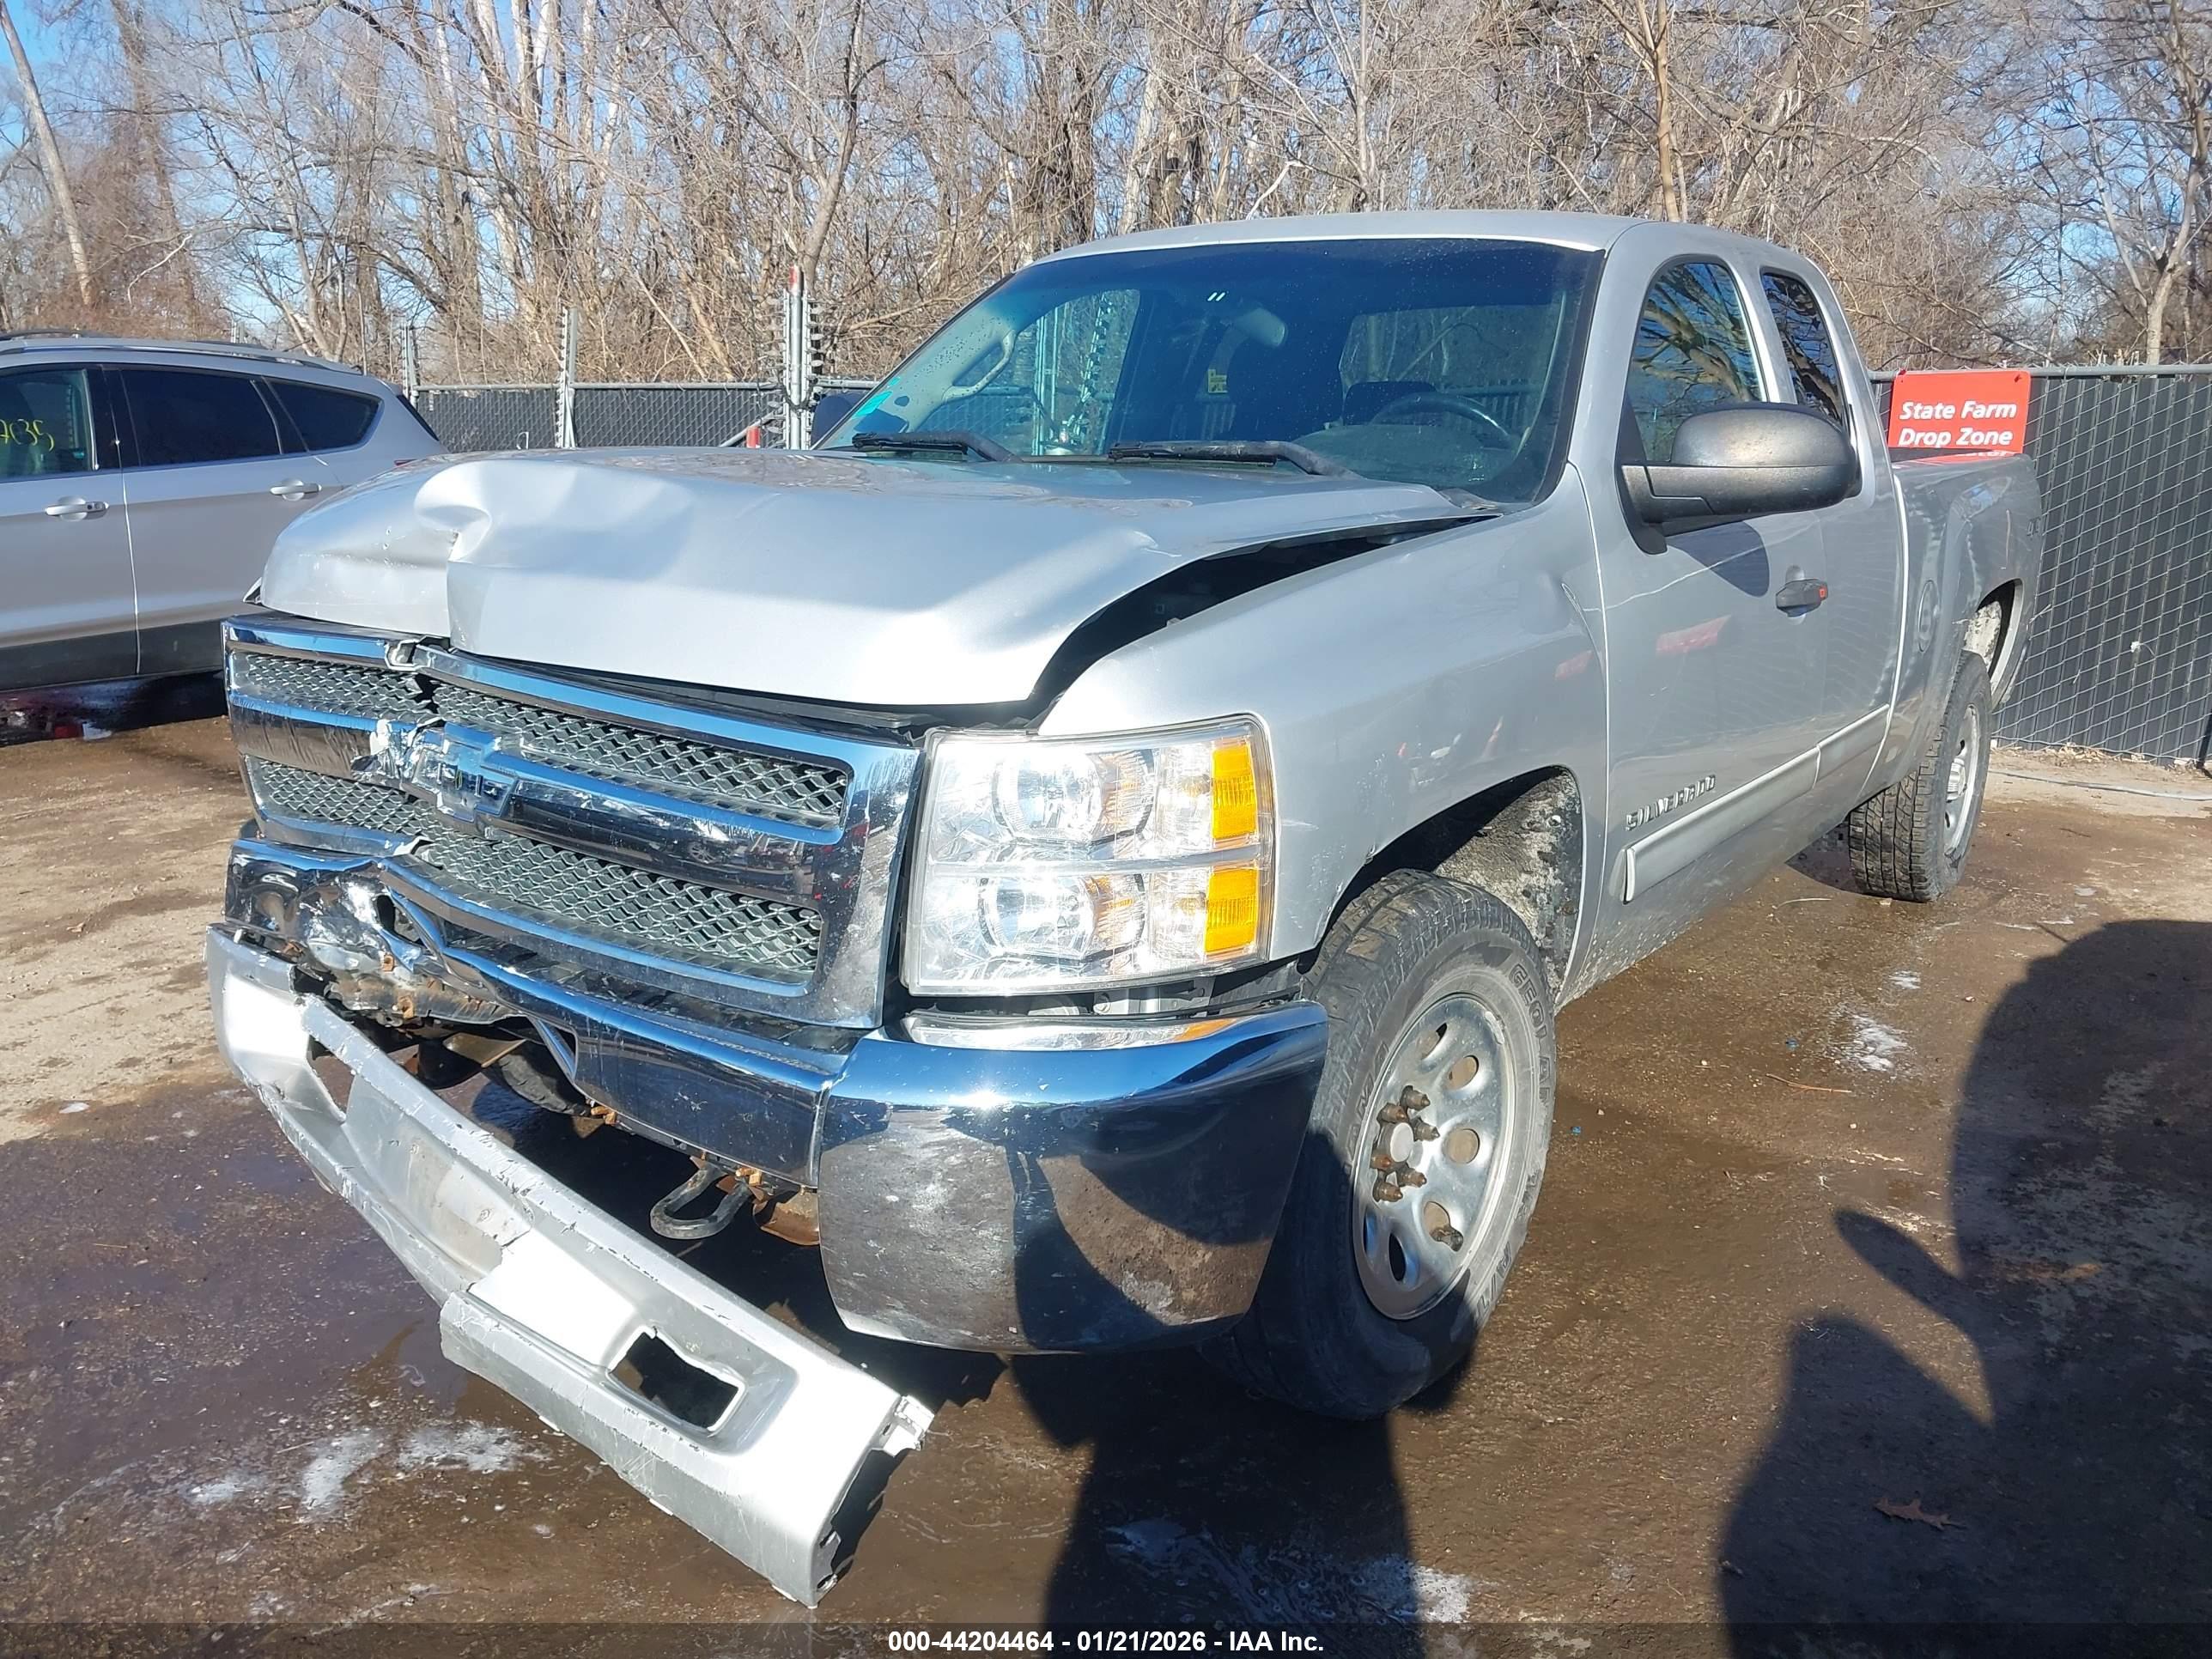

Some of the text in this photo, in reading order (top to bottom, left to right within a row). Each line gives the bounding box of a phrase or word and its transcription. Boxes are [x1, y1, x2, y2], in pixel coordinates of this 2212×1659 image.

[1899, 400, 2017, 420] State Farm
[1898, 427, 2013, 447] Drop Zone
[1626, 775, 1716, 831] SILVERADO
